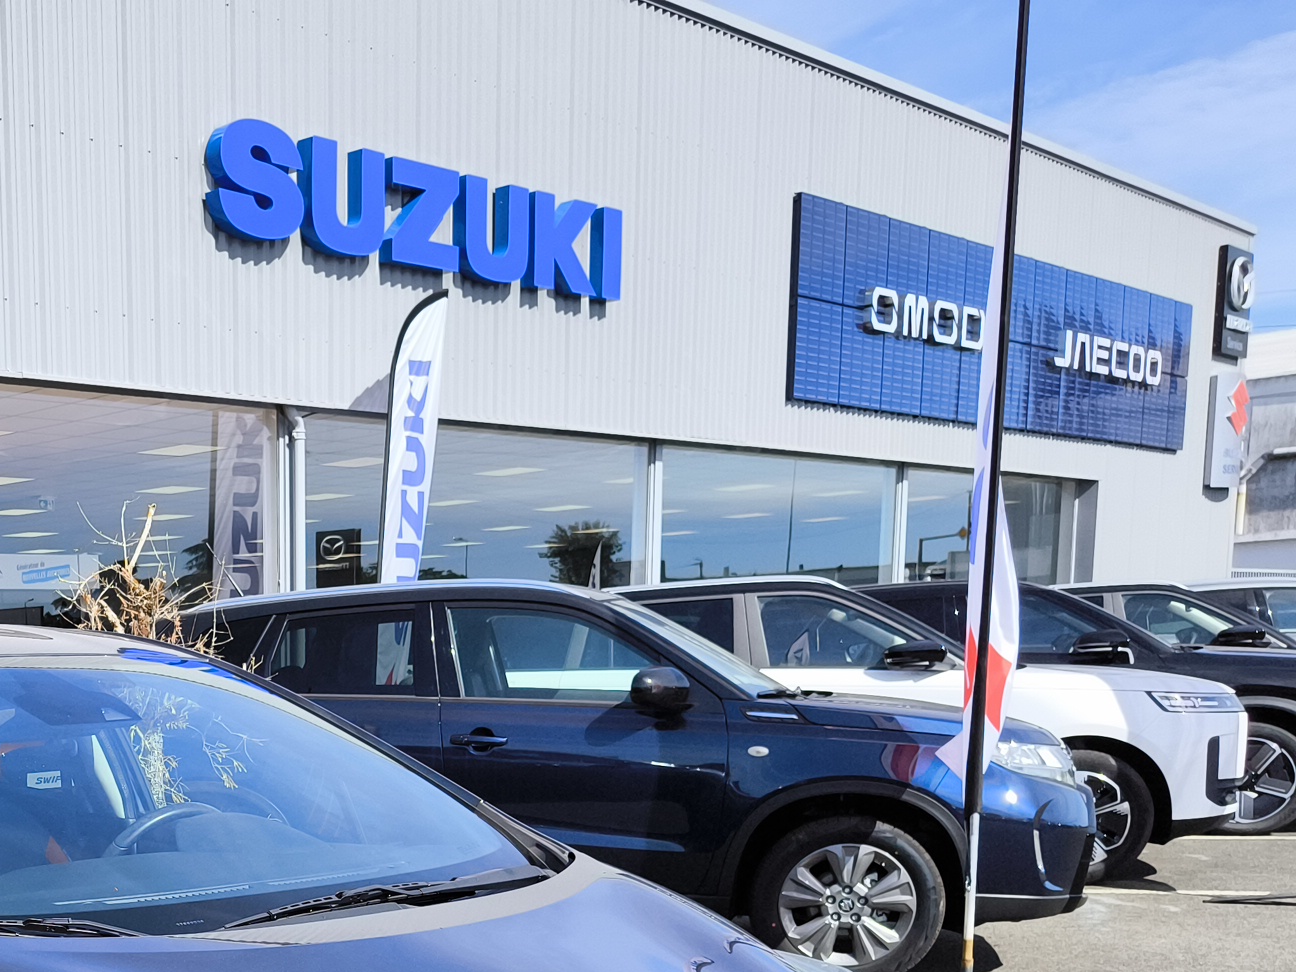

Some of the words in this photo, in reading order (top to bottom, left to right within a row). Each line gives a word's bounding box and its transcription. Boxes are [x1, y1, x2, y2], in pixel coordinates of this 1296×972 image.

[205, 118, 623, 301] SUZUKI
[870, 286, 986, 351] OMOD
[395, 359, 432, 583] UZUKI
[35, 775, 62, 785] SWIF
